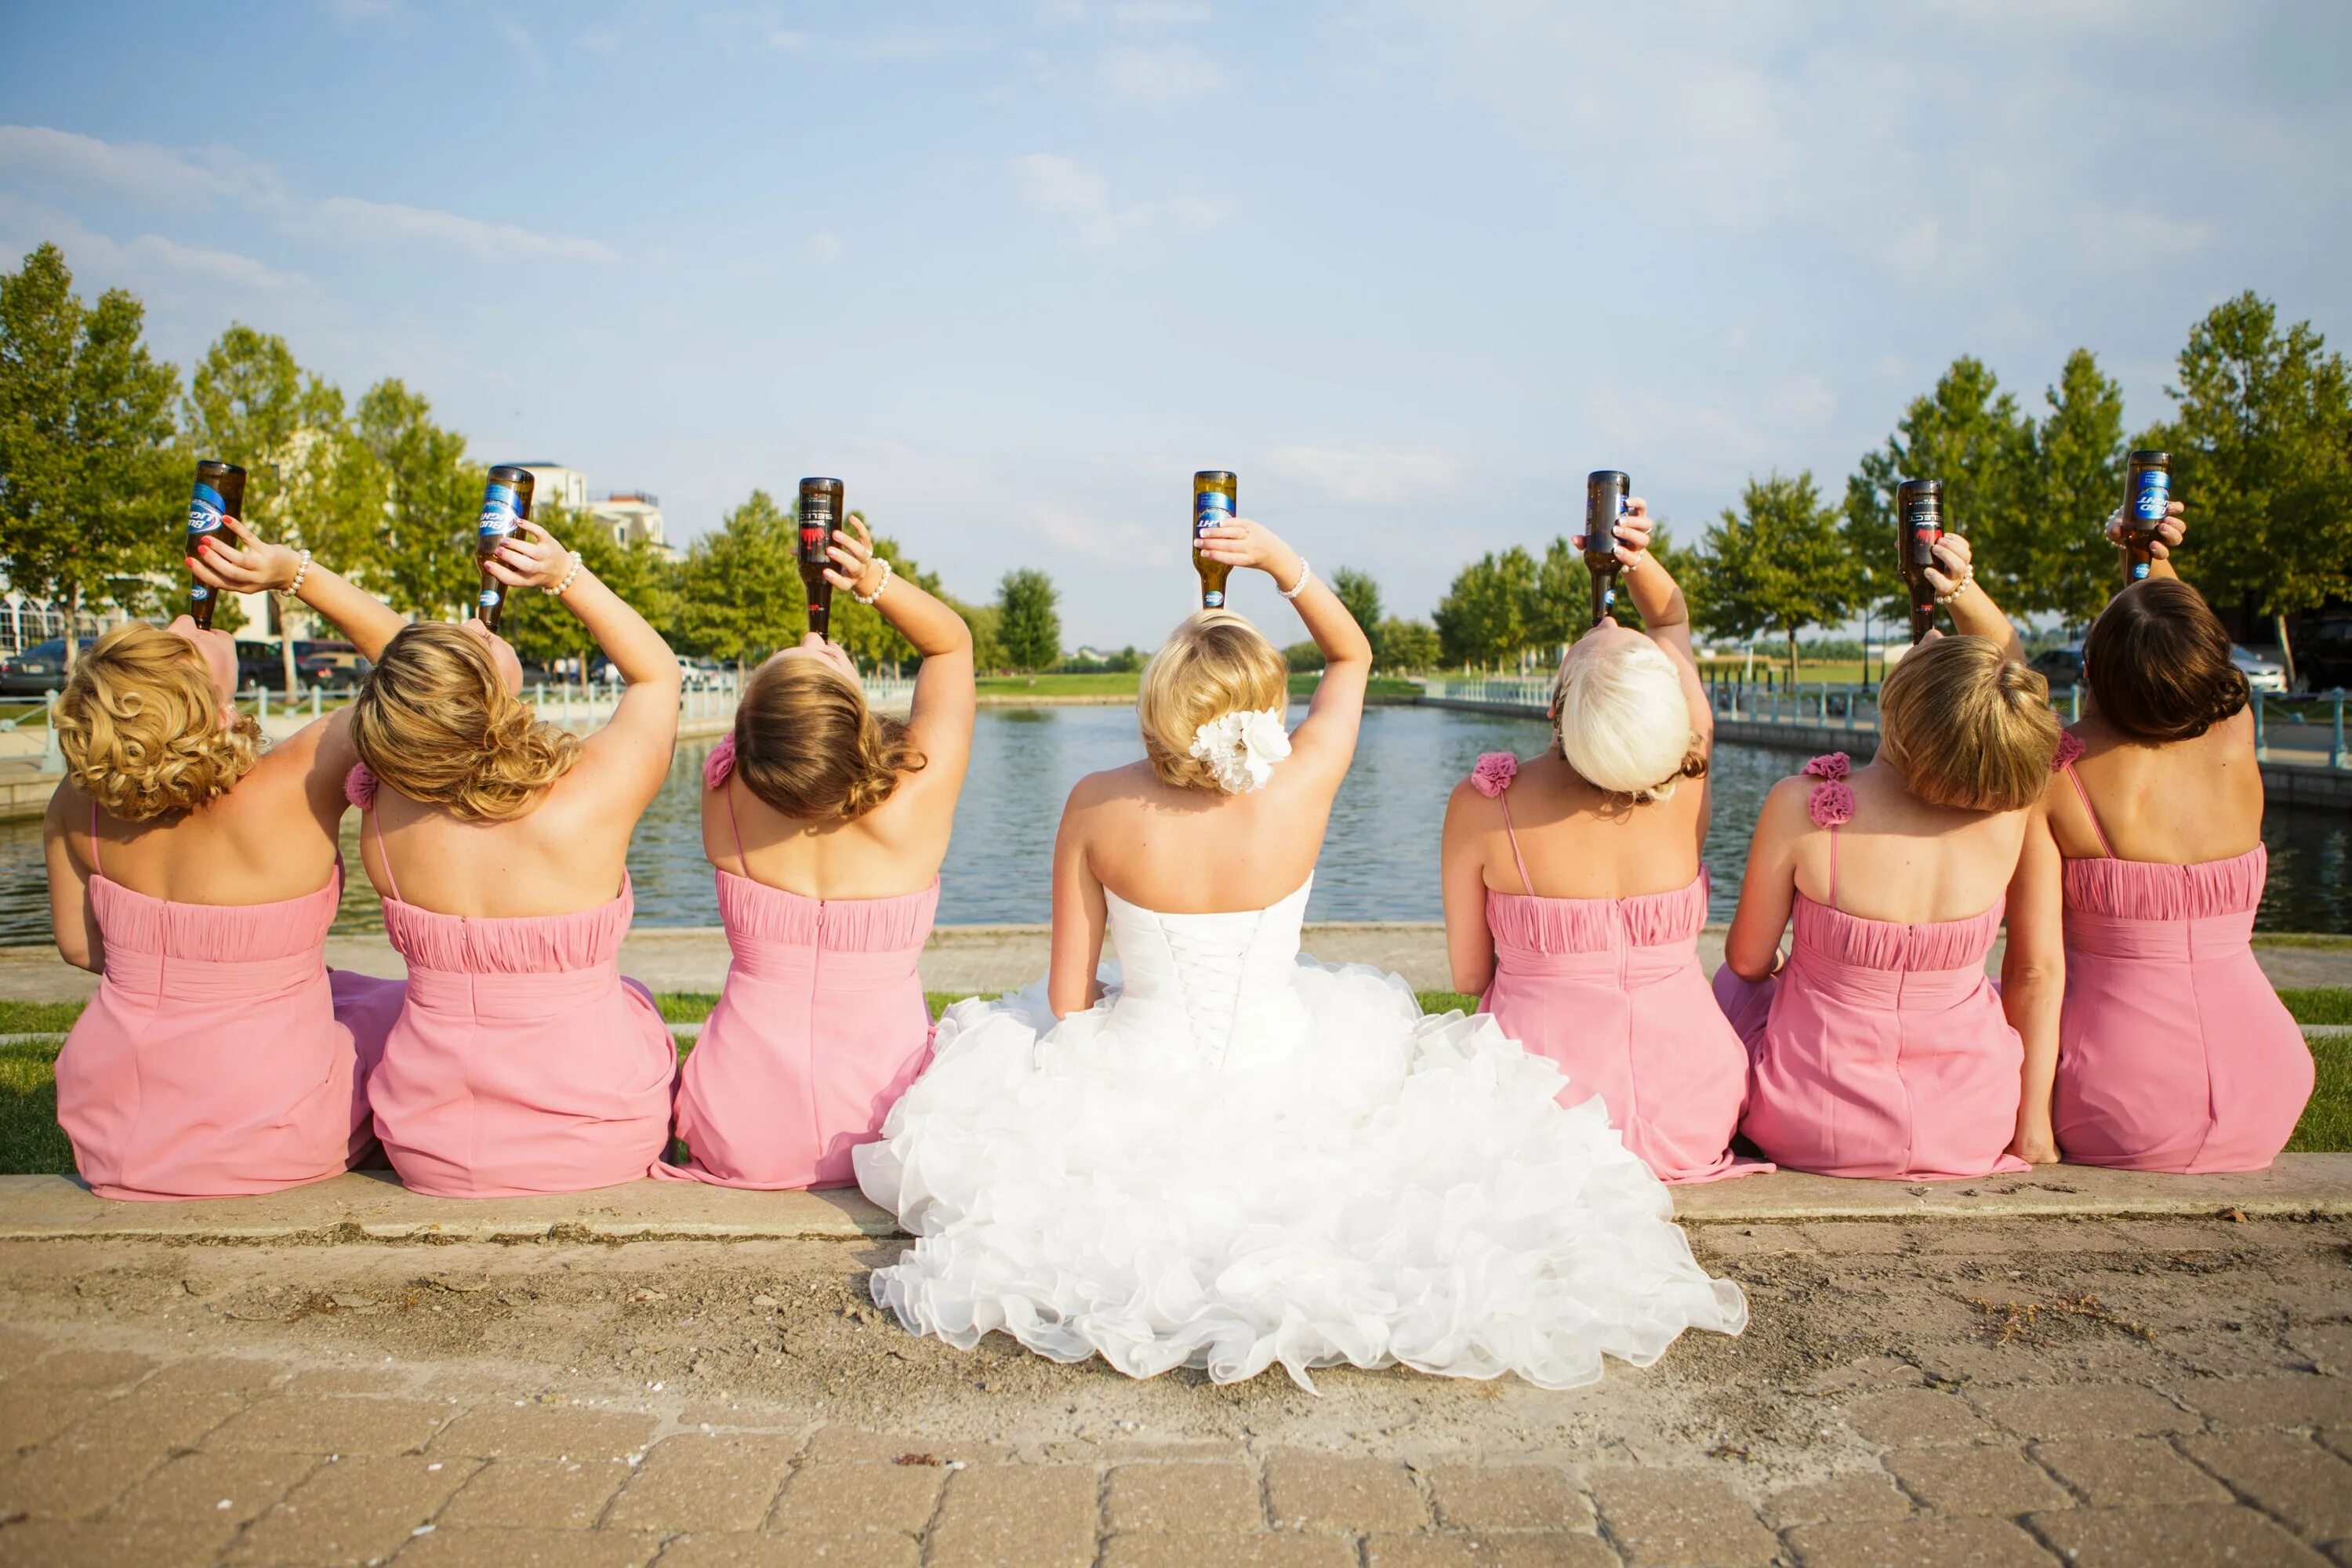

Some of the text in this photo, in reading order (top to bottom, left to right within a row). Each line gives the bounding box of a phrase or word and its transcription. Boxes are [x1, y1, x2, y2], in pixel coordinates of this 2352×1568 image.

[2136, 496, 2169, 509] LIGHT
[2140, 504, 2166, 514] BUD
[188, 519, 205, 529] BU
